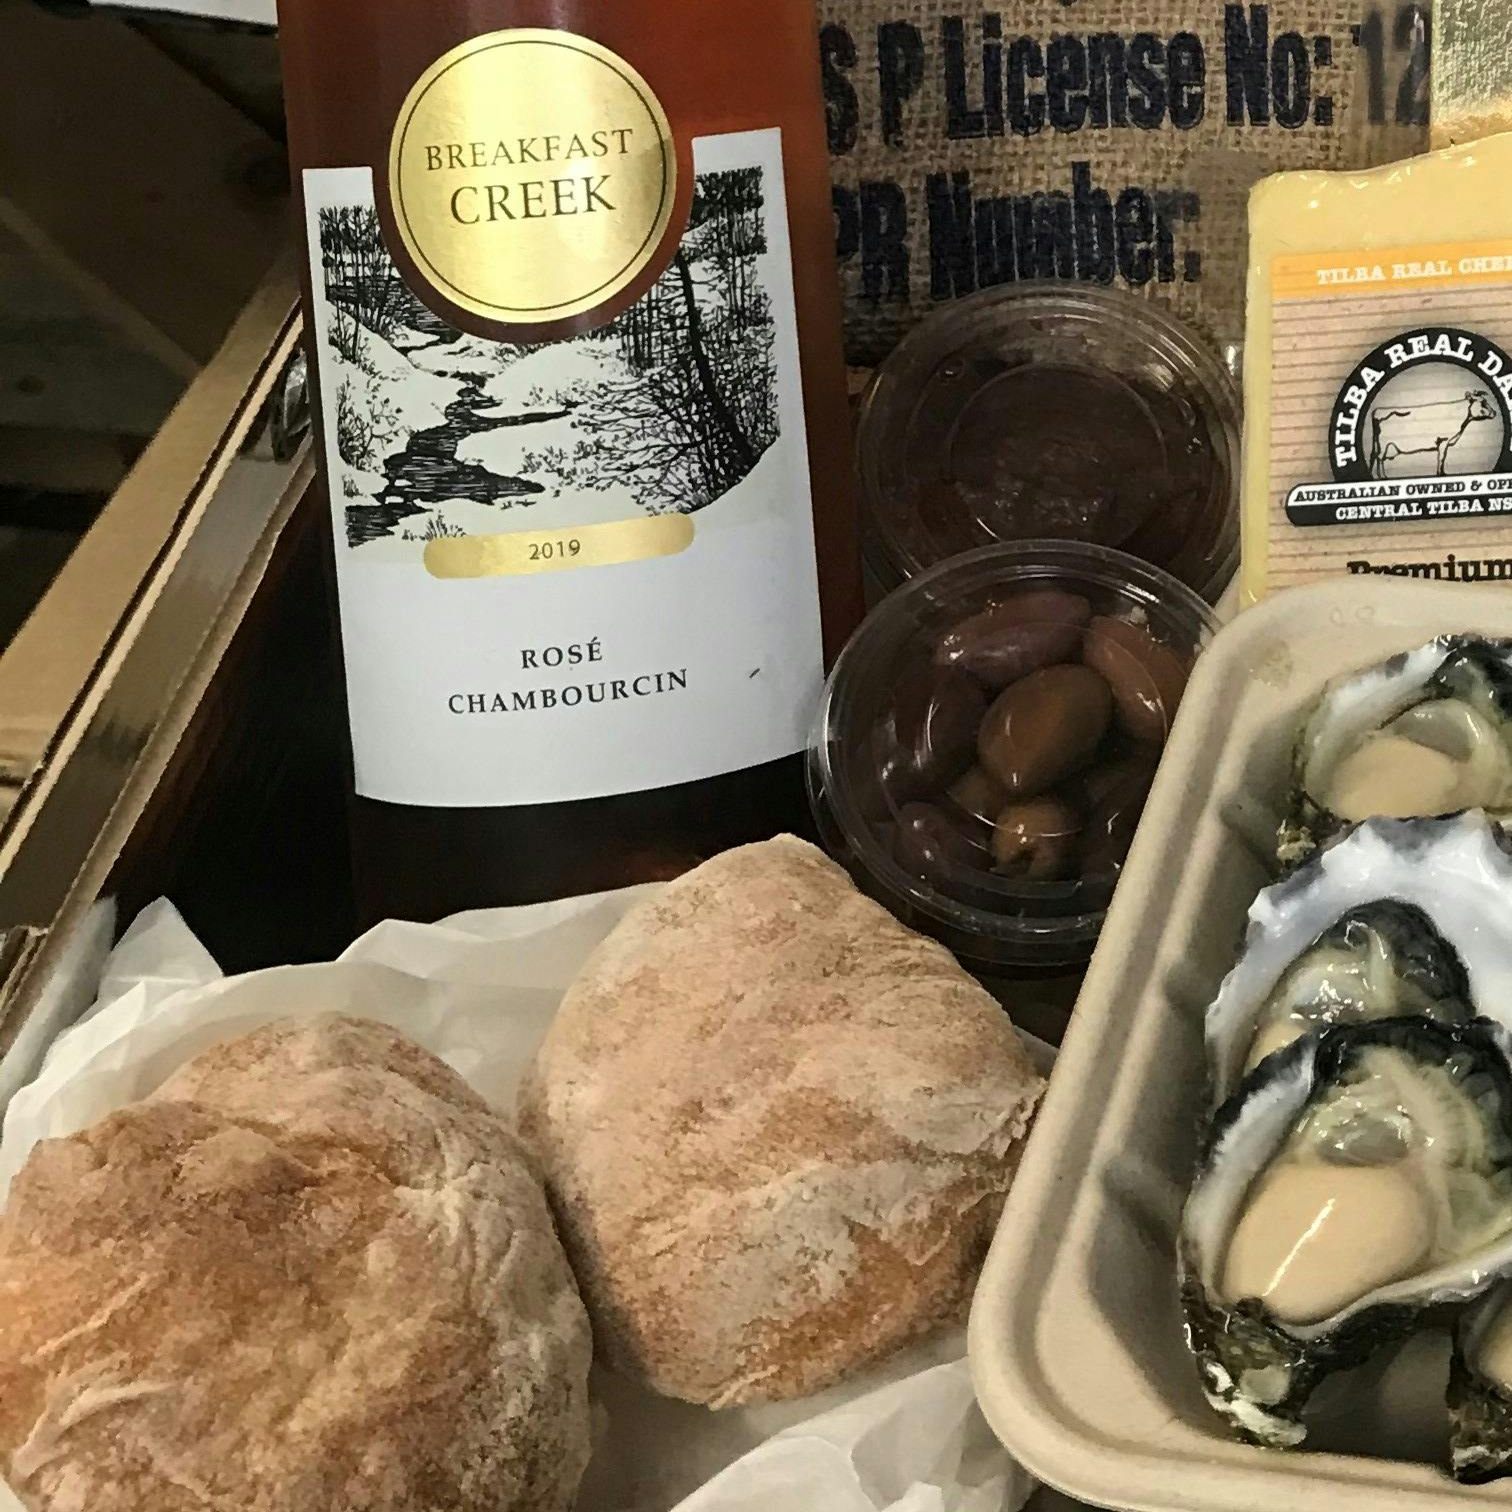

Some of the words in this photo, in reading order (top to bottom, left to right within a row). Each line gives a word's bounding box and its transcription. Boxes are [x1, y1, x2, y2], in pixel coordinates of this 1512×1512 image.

[942, 13, 1206, 140] License
[1223, 4, 1334, 130] No:
[425, 128, 634, 172] BREAKFAST
[450, 174, 618, 226] CREEK
[1316, 266, 1386, 286] TILBA
[1391, 259, 1453, 280] REAL
[1334, 366, 1386, 468] TILBA
[1384, 333, 1478, 369] REAL
[1294, 484, 1401, 504] AUSTRALIAN
[1405, 481, 1466, 496] OWNED
[1470, 479, 1483, 492] &
[1335, 501, 1423, 522] CENTRAL
[1427, 498, 1484, 516] TILBA
[528, 538, 582, 562] 2019
[520, 636, 603, 671] ROSÉ
[447, 668, 689, 715] CHAMBOURCIN
